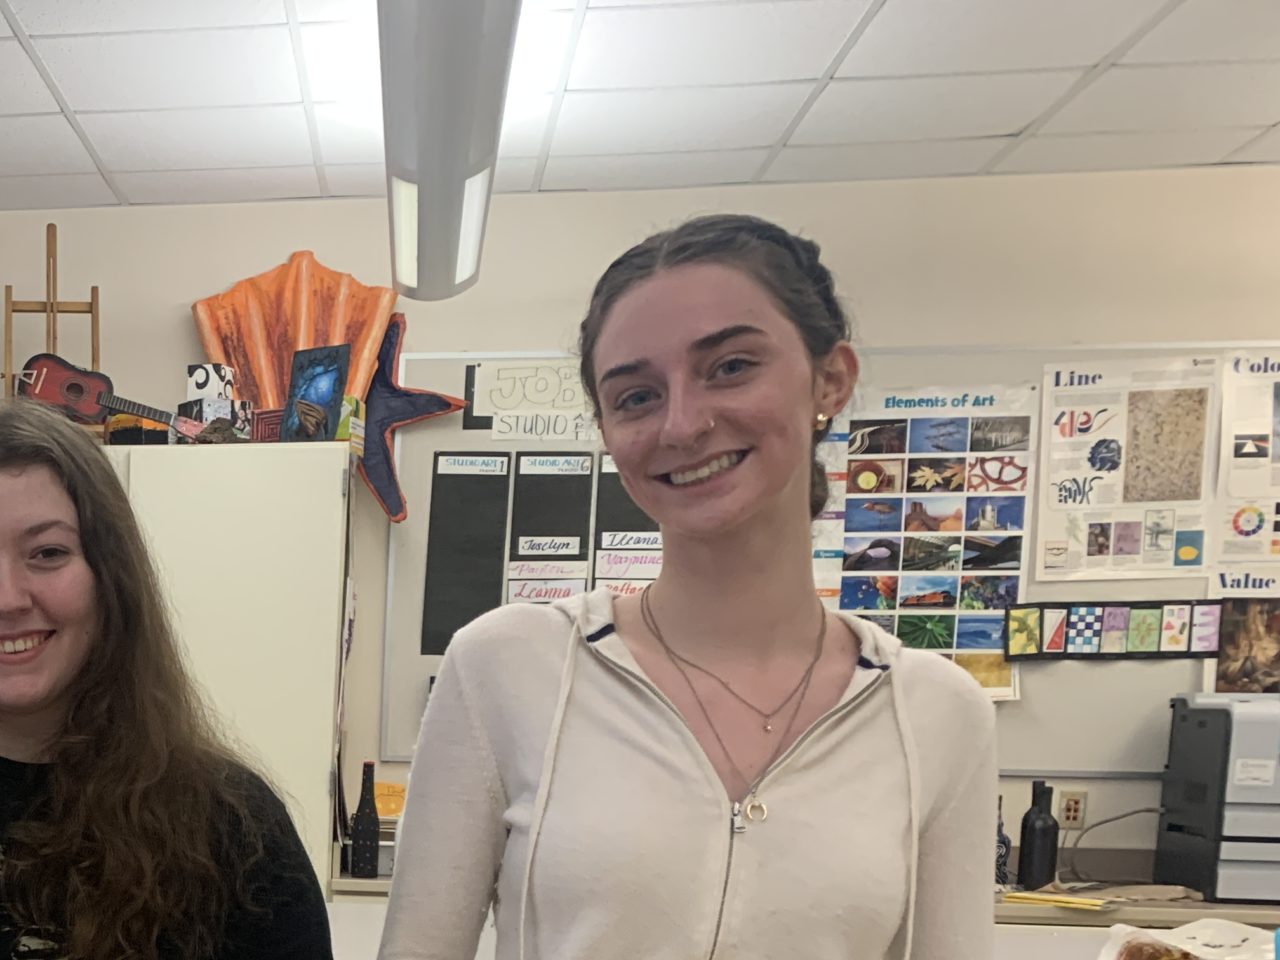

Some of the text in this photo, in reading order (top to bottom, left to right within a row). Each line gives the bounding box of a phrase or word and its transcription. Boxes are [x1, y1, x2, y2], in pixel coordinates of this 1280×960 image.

[1054, 370, 1103, 388] Line
[884, 393, 995, 410] Elements of Art
[498, 414, 568, 436] STUDIO
[1218, 572, 1276, 589] Value
